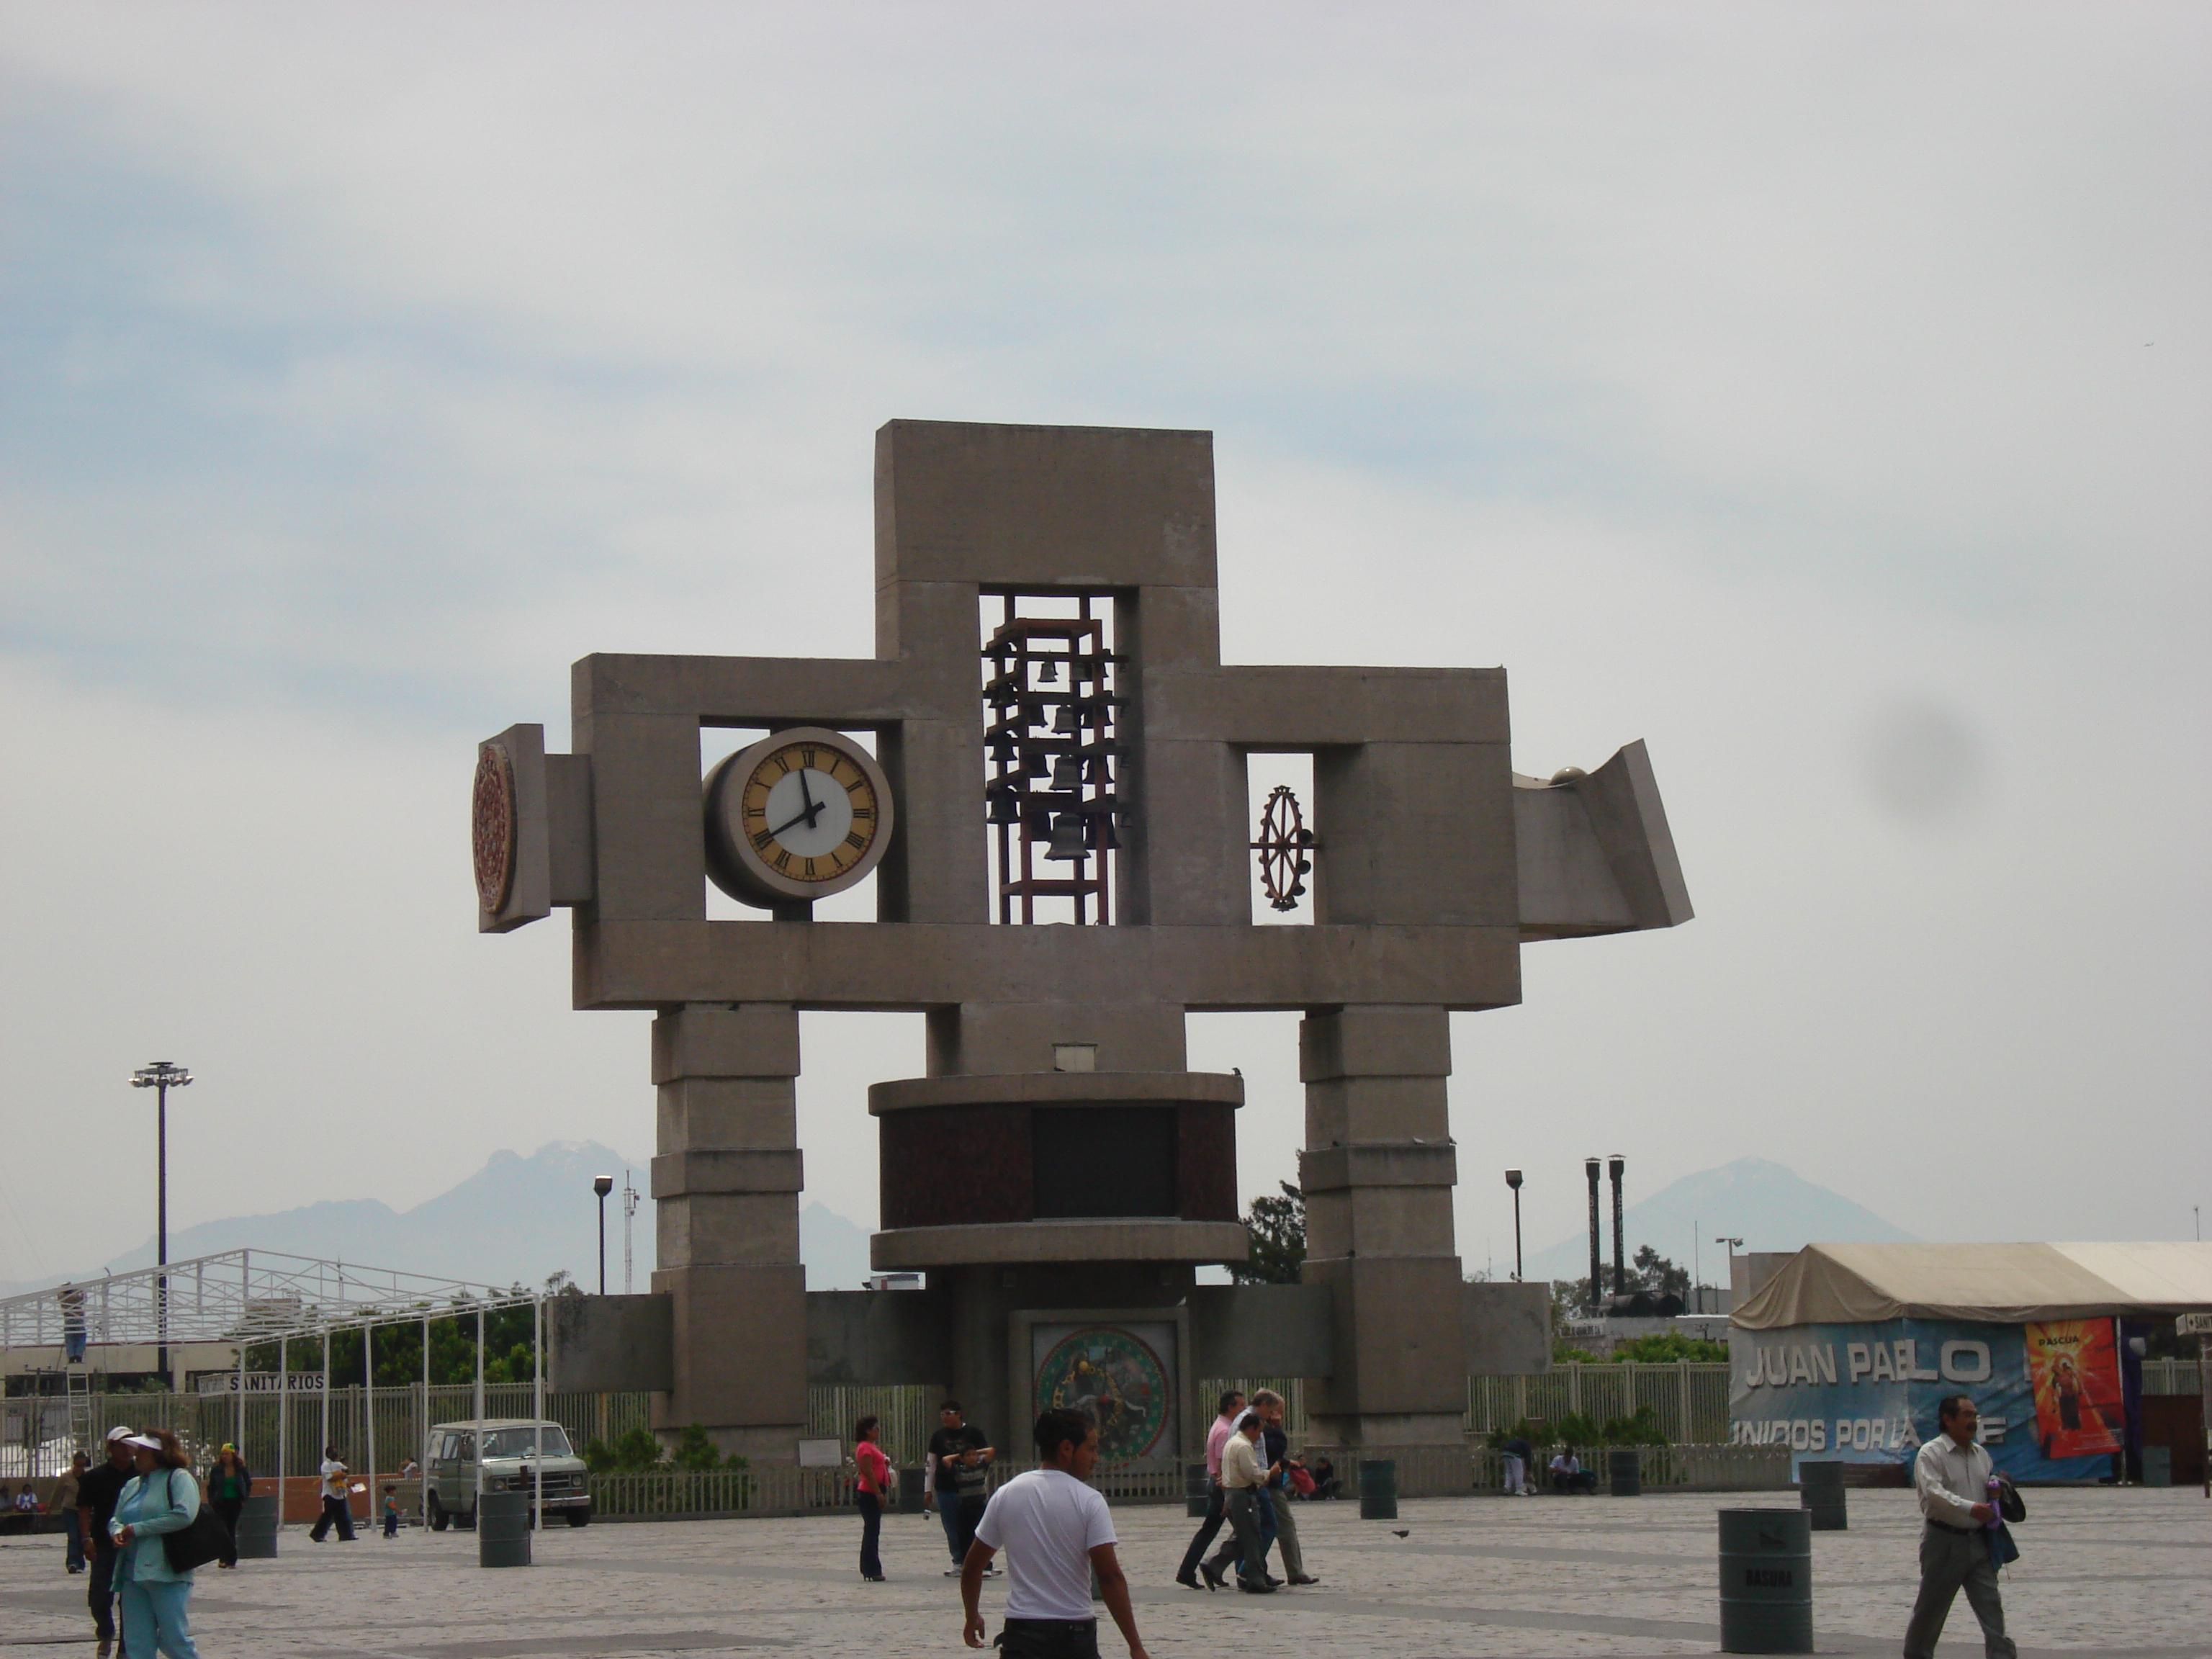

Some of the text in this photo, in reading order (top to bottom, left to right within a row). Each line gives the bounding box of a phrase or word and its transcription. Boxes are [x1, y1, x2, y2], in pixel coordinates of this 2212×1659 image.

[846, 781, 863, 793] II
[853, 809, 870, 818] III
[2038, 1335, 2080, 1346] PASCUA
[1745, 1344, 1838, 1387] JUAN
[1847, 1339, 1991, 1383] PABLO
[230, 1376, 324, 1391] SNITRIOS
[1836, 1419, 1886, 1450] POR
[1745, 1569, 1792, 1588] BASURA
